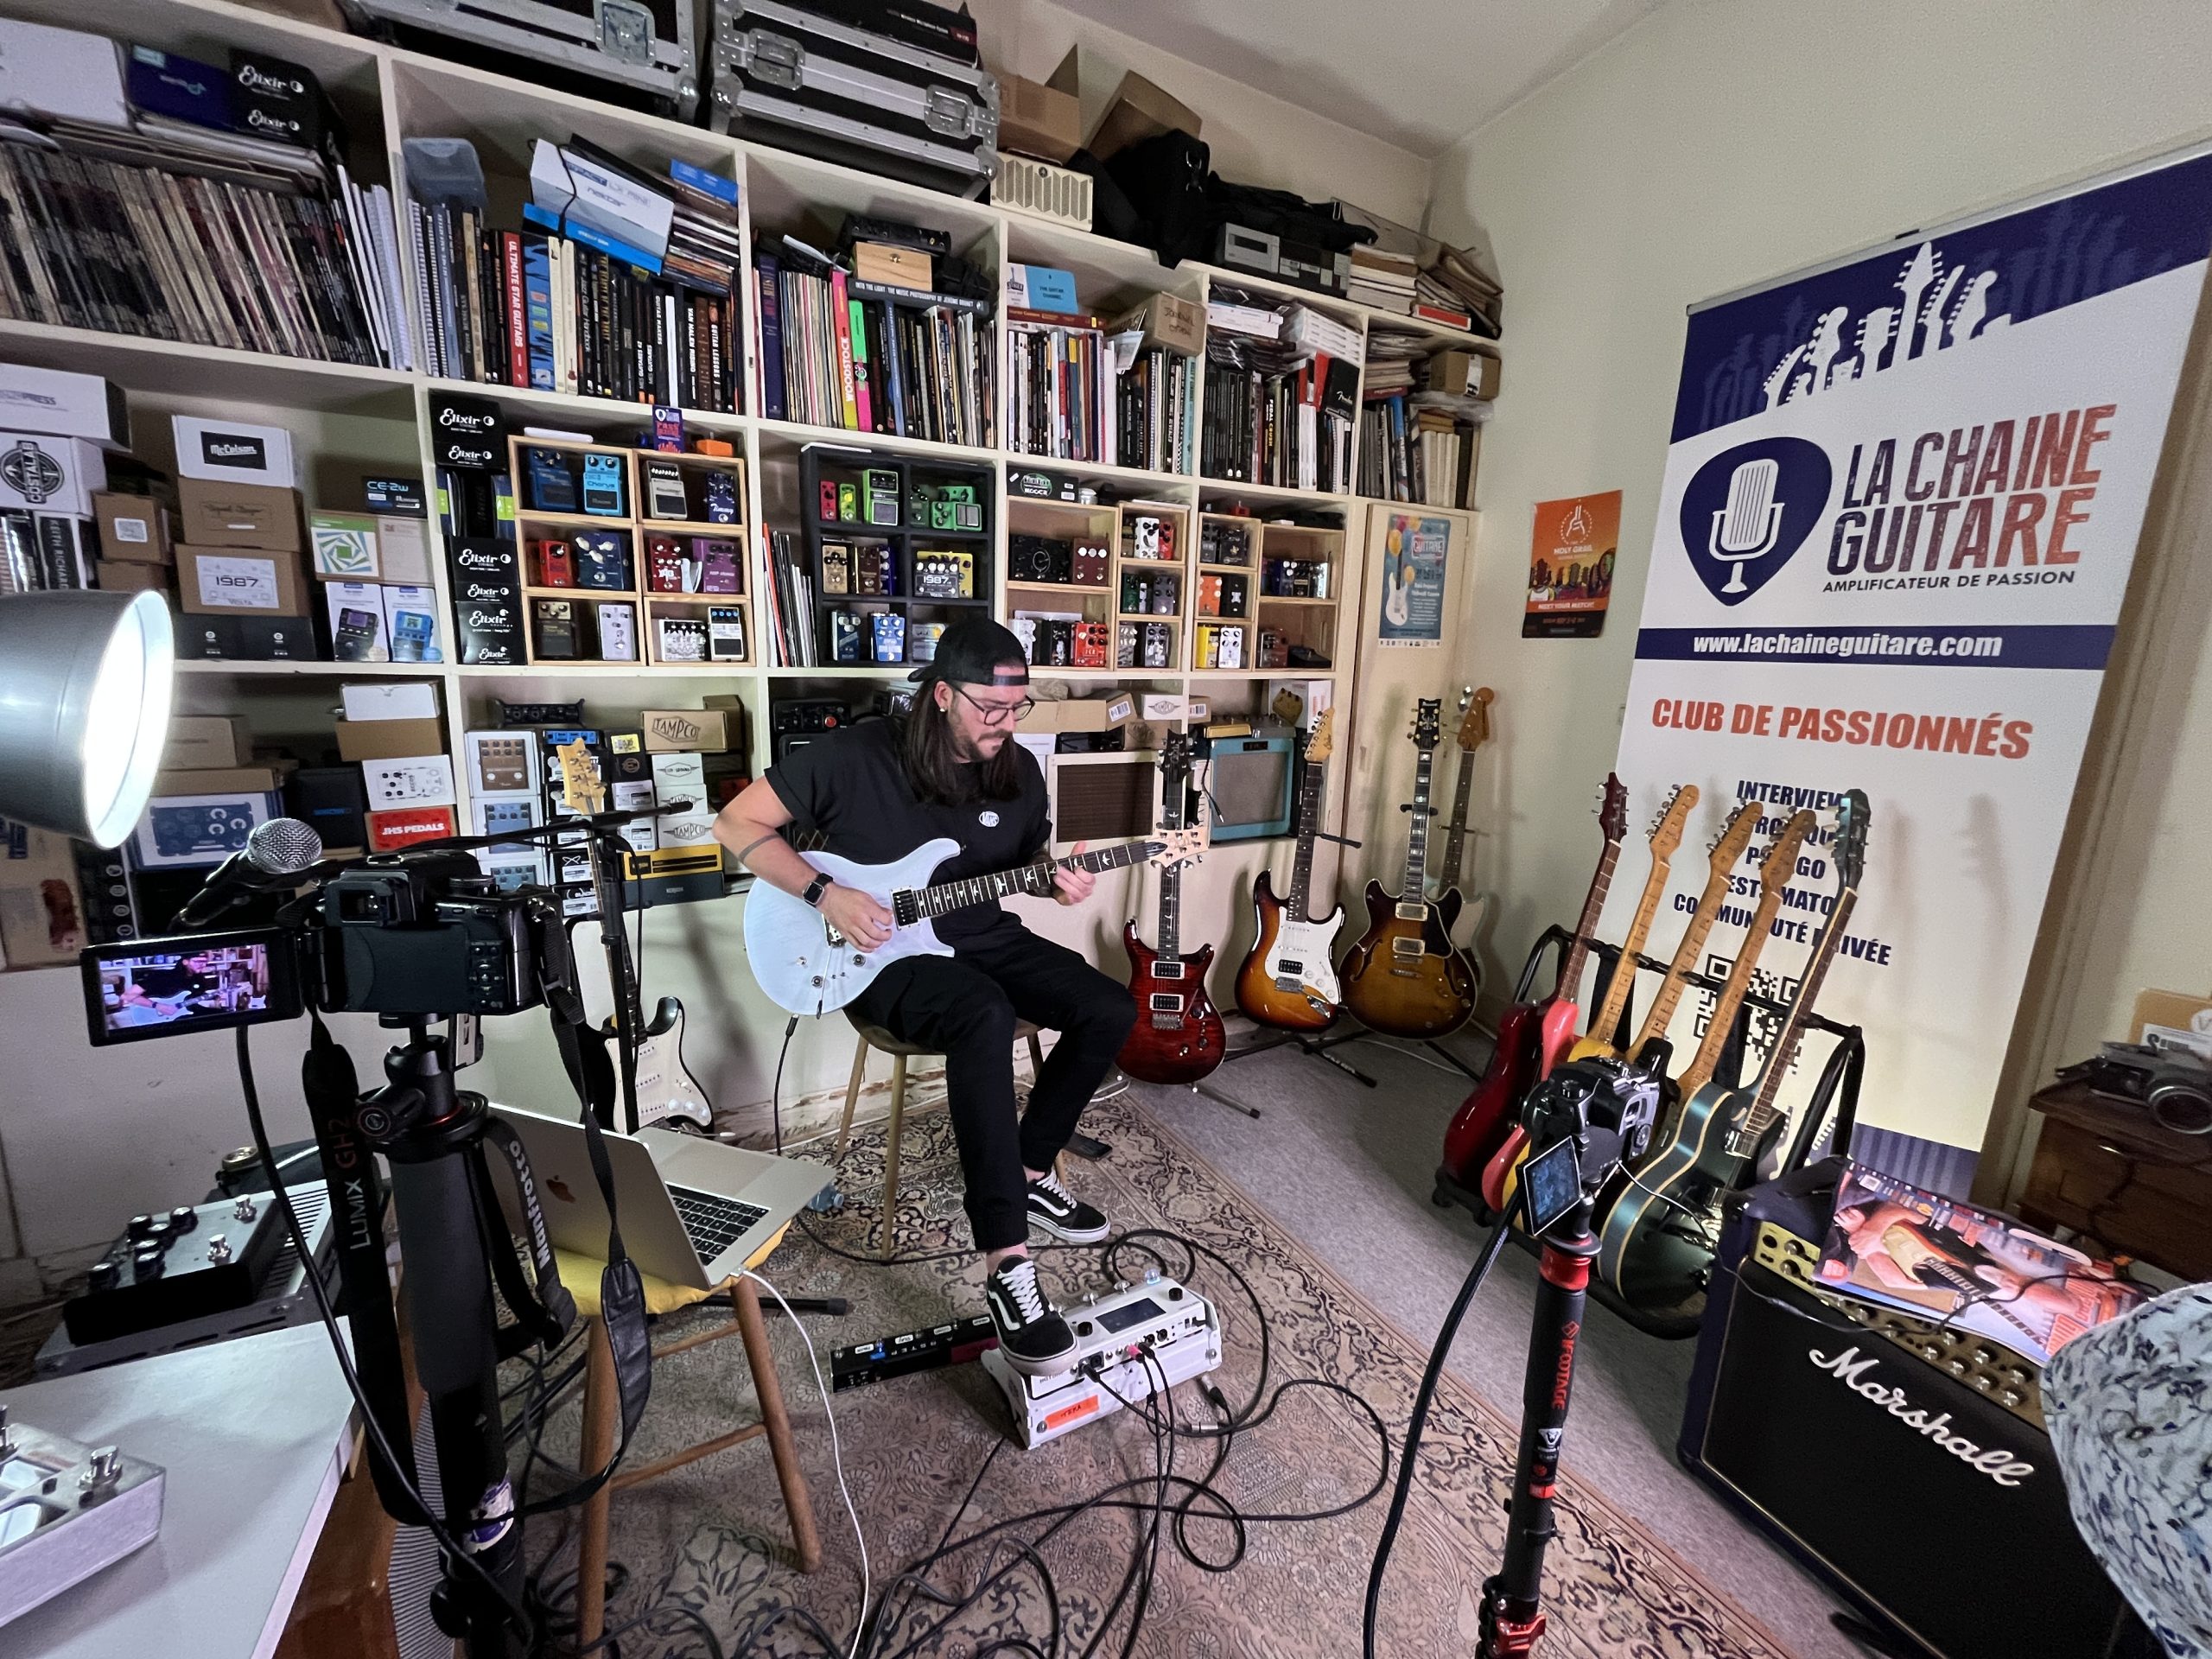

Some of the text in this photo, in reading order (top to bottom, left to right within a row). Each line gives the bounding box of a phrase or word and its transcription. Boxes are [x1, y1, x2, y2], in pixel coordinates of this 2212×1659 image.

[238, 65, 287, 91] Elixir
[248, 109, 287, 131] Elixir
[508, 240, 524, 348] ULTIMATE STAR GUITARS
[841, 337, 854, 402] WOODSTOCK
[439, 408, 480, 426] Elixir
[448, 445, 481, 460] Elixir
[1841, 404, 2118, 509] LA CHAINE
[22, 442, 41, 503] COSTALAB
[49, 519, 63, 546] KEITH
[1826, 487, 2097, 575] GUITARE
[458, 549, 499, 565] Elixir
[216, 576, 258, 588] 1987
[467, 584, 499, 597] Elixir
[924, 575, 950, 584] 1987
[1822, 570, 2075, 593] AMPLIFICATEUR DE PASSION
[469, 610, 507, 627] Elixir
[479, 647, 506, 659] Elixir
[1693, 632, 2002, 658] www.lachaineguitare.com
[656, 718, 697, 739] TAMPCO
[1652, 698, 2034, 760] CLUB DE PASSIONNÉS
[382, 823, 445, 836] JHS PEDALS
[674, 823, 705, 838] TAMPCO
[1674, 893, 1808, 944] COMUNUTÉ
[328, 1118, 373, 1250] LUMIX GH2
[508, 1139, 551, 1270] Manfrotto
[1808, 1346, 2035, 1486] Marshall
